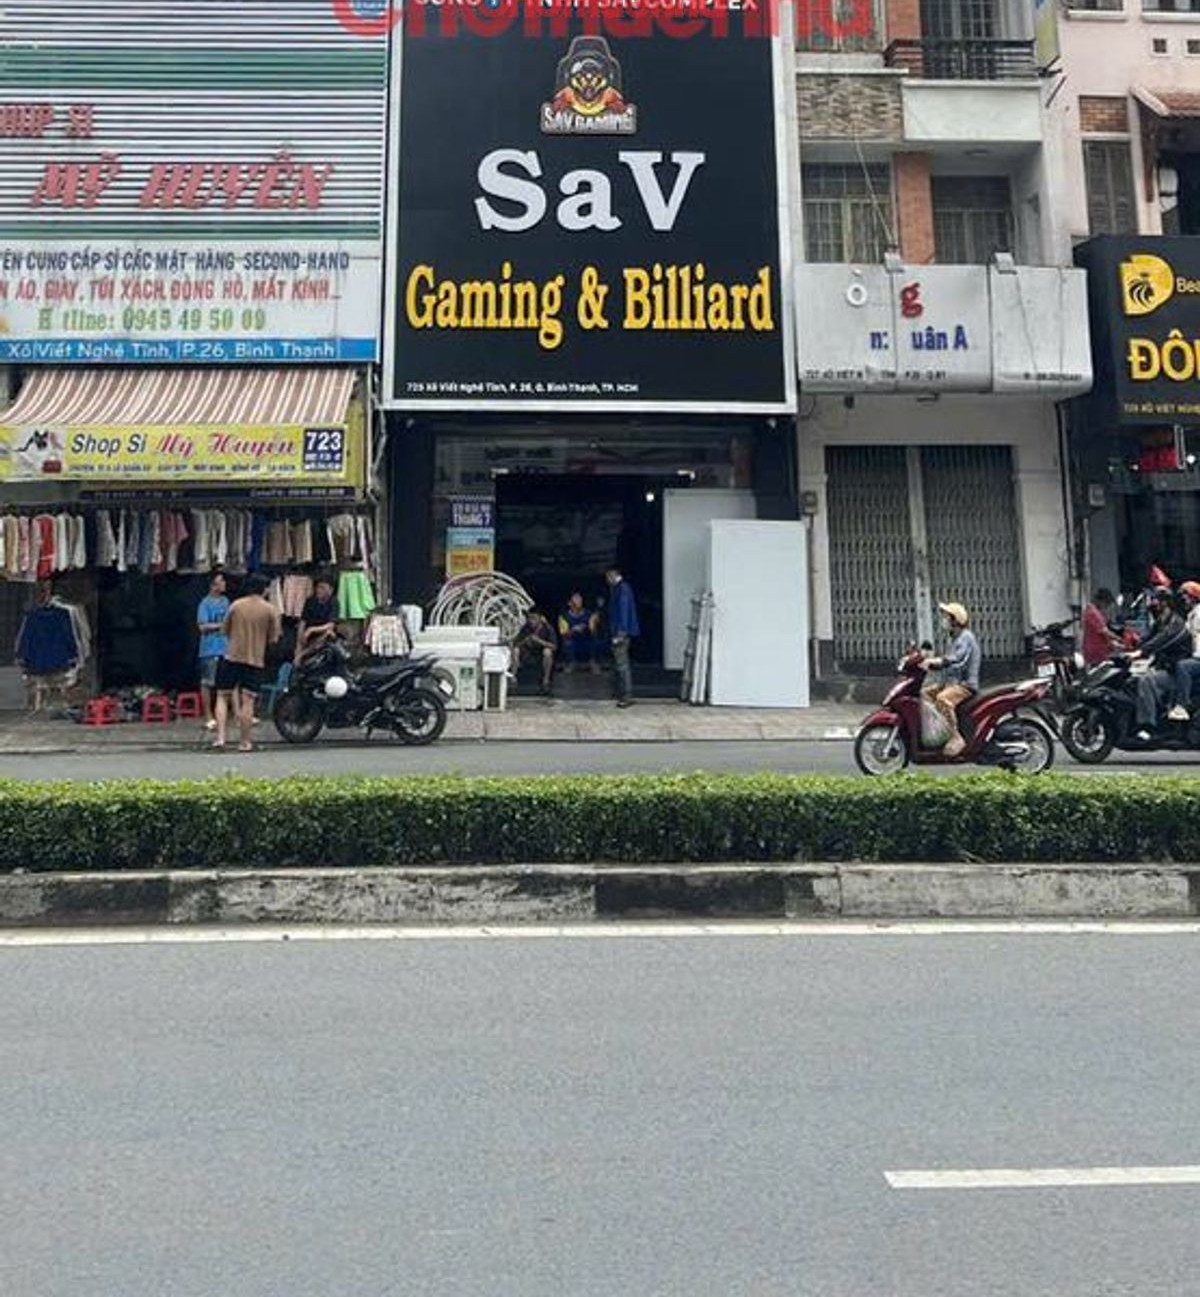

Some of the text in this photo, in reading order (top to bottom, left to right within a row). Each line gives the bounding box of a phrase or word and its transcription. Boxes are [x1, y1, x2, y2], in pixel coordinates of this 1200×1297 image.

[475, 148, 706, 233] SaV
[244, 252, 350, 271] SECOND-HAND
[406, 262, 774, 349] Gaming & Billiard
[72, 434, 121, 457] Shop
[306, 431, 342, 451] 723
